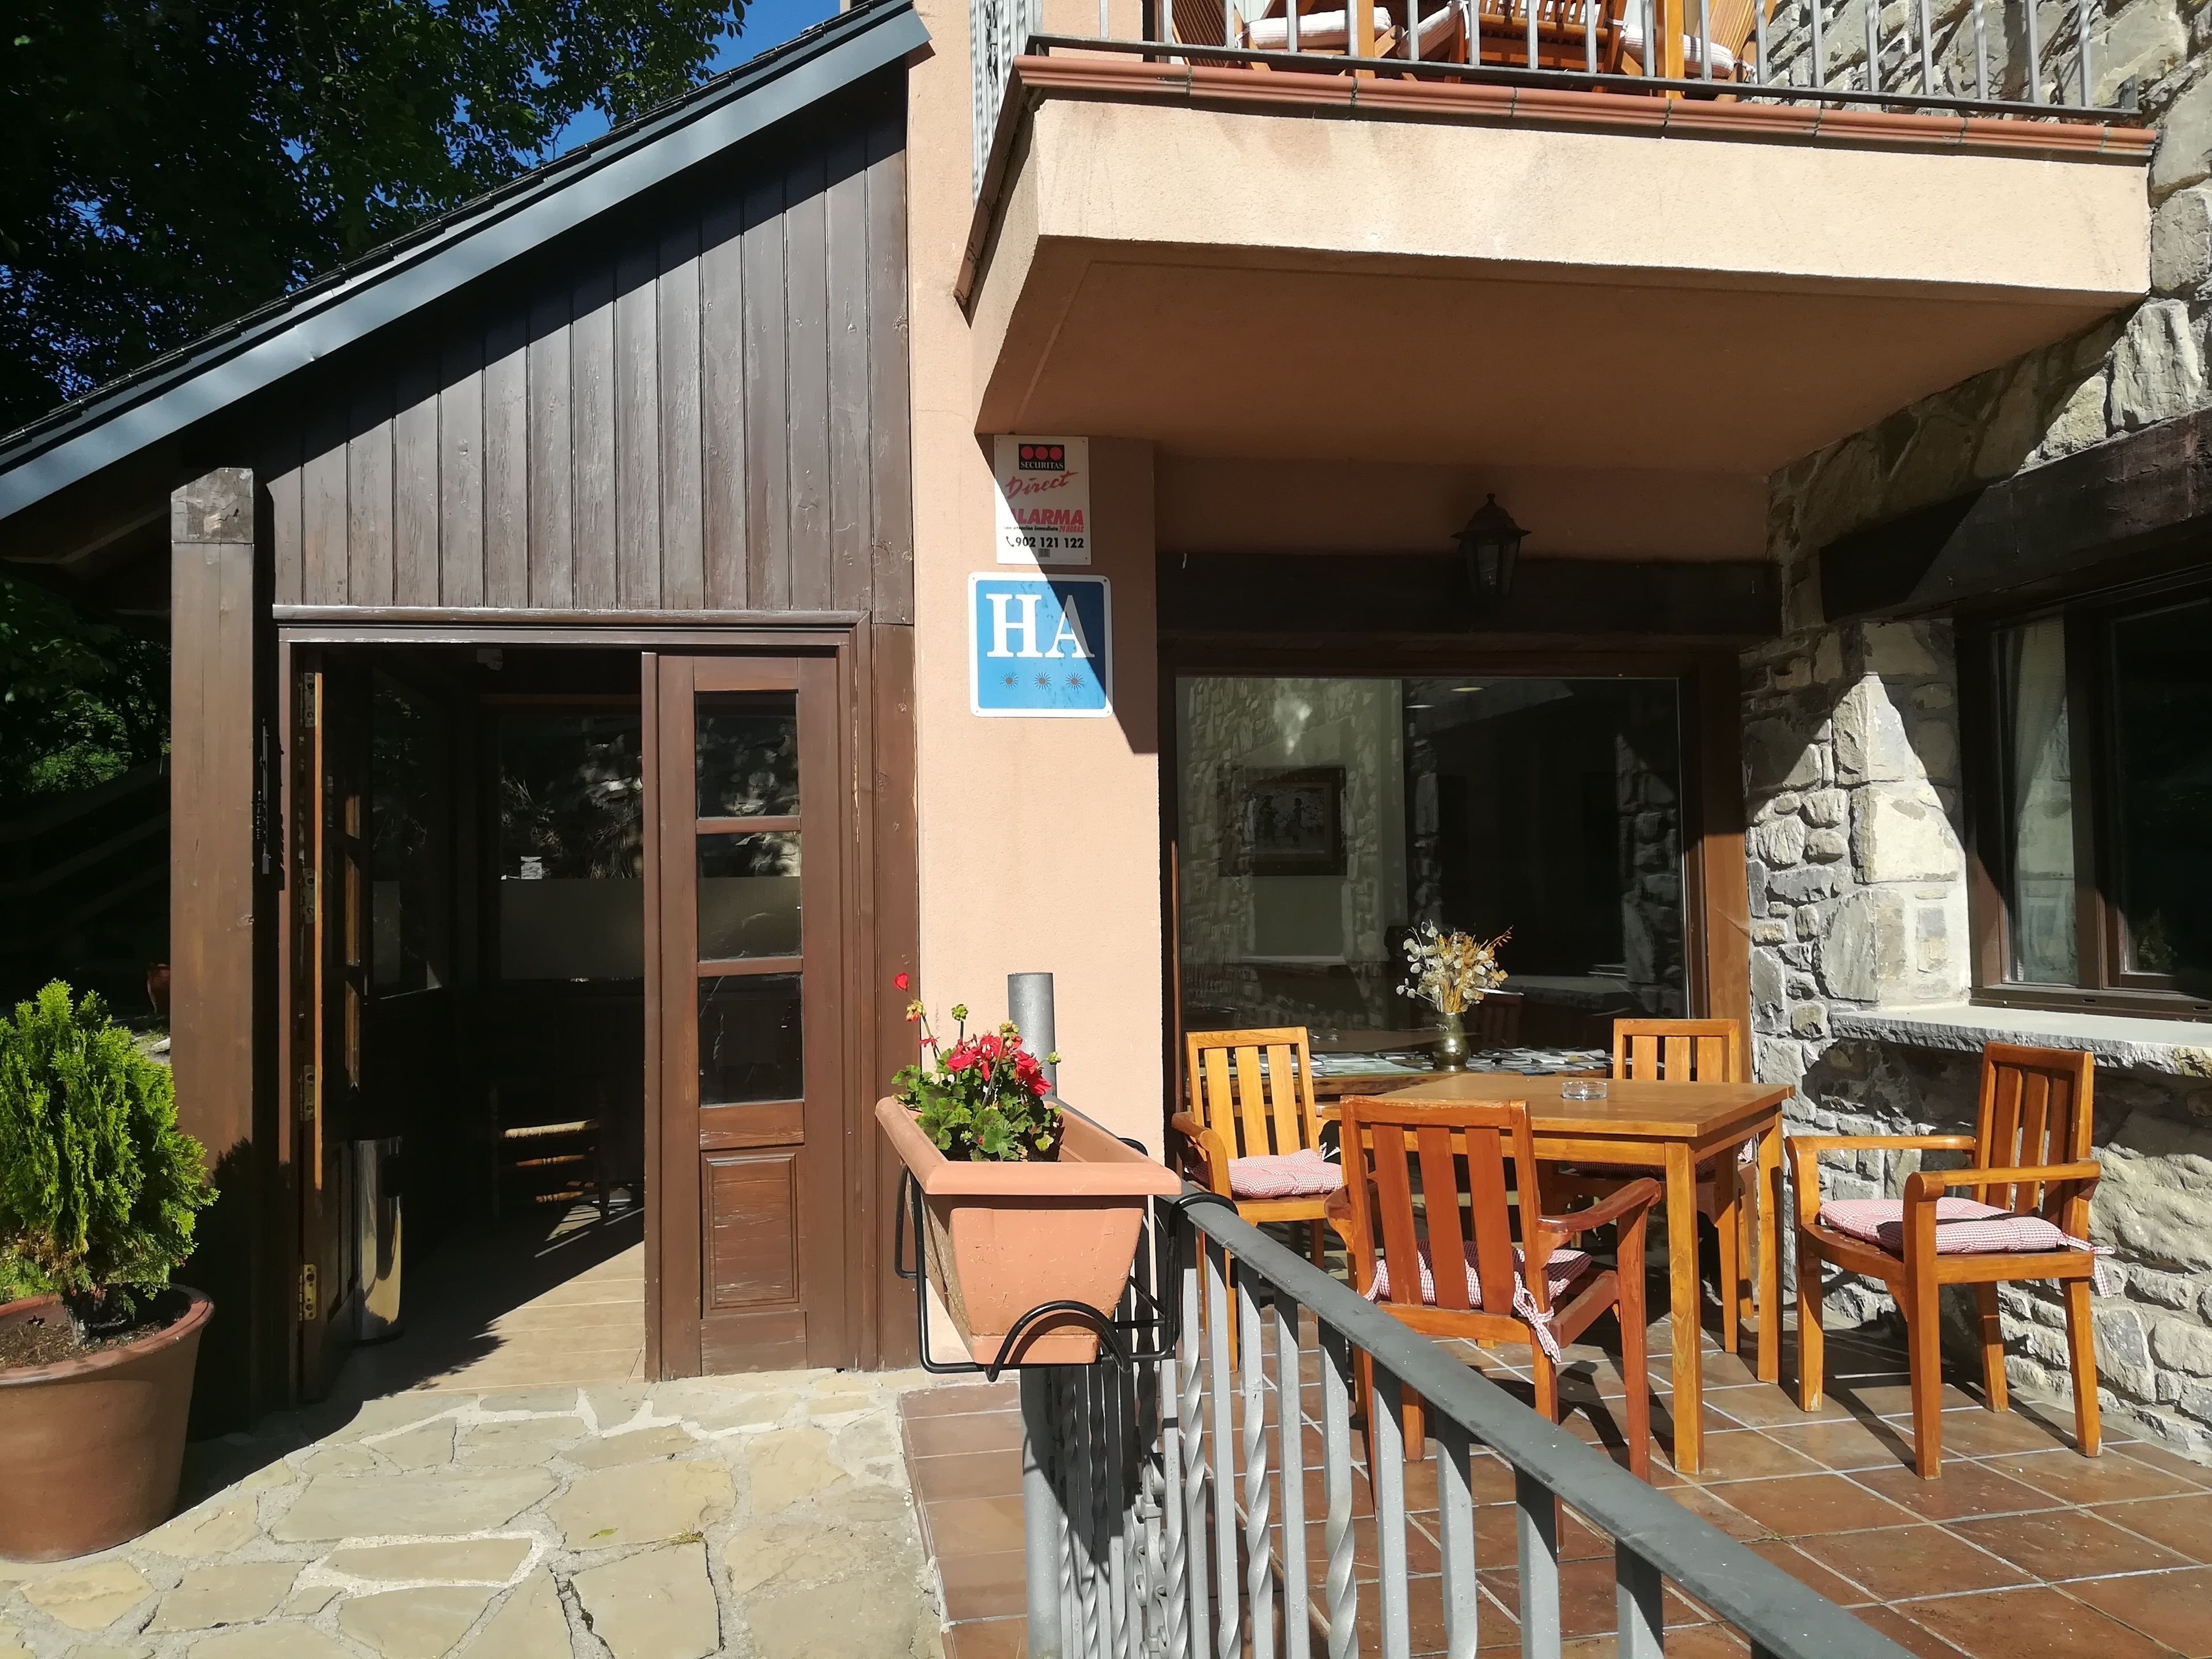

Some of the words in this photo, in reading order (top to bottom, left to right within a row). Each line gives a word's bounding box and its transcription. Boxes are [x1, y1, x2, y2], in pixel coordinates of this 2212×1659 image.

[1021, 461, 1063, 469] SECURITAS
[1005, 470, 1079, 500] Direct
[1016, 536, 1036, 548] 902
[1040, 537, 1059, 548] 121
[1065, 537, 1084, 548] 122
[986, 593, 1095, 658] HA
